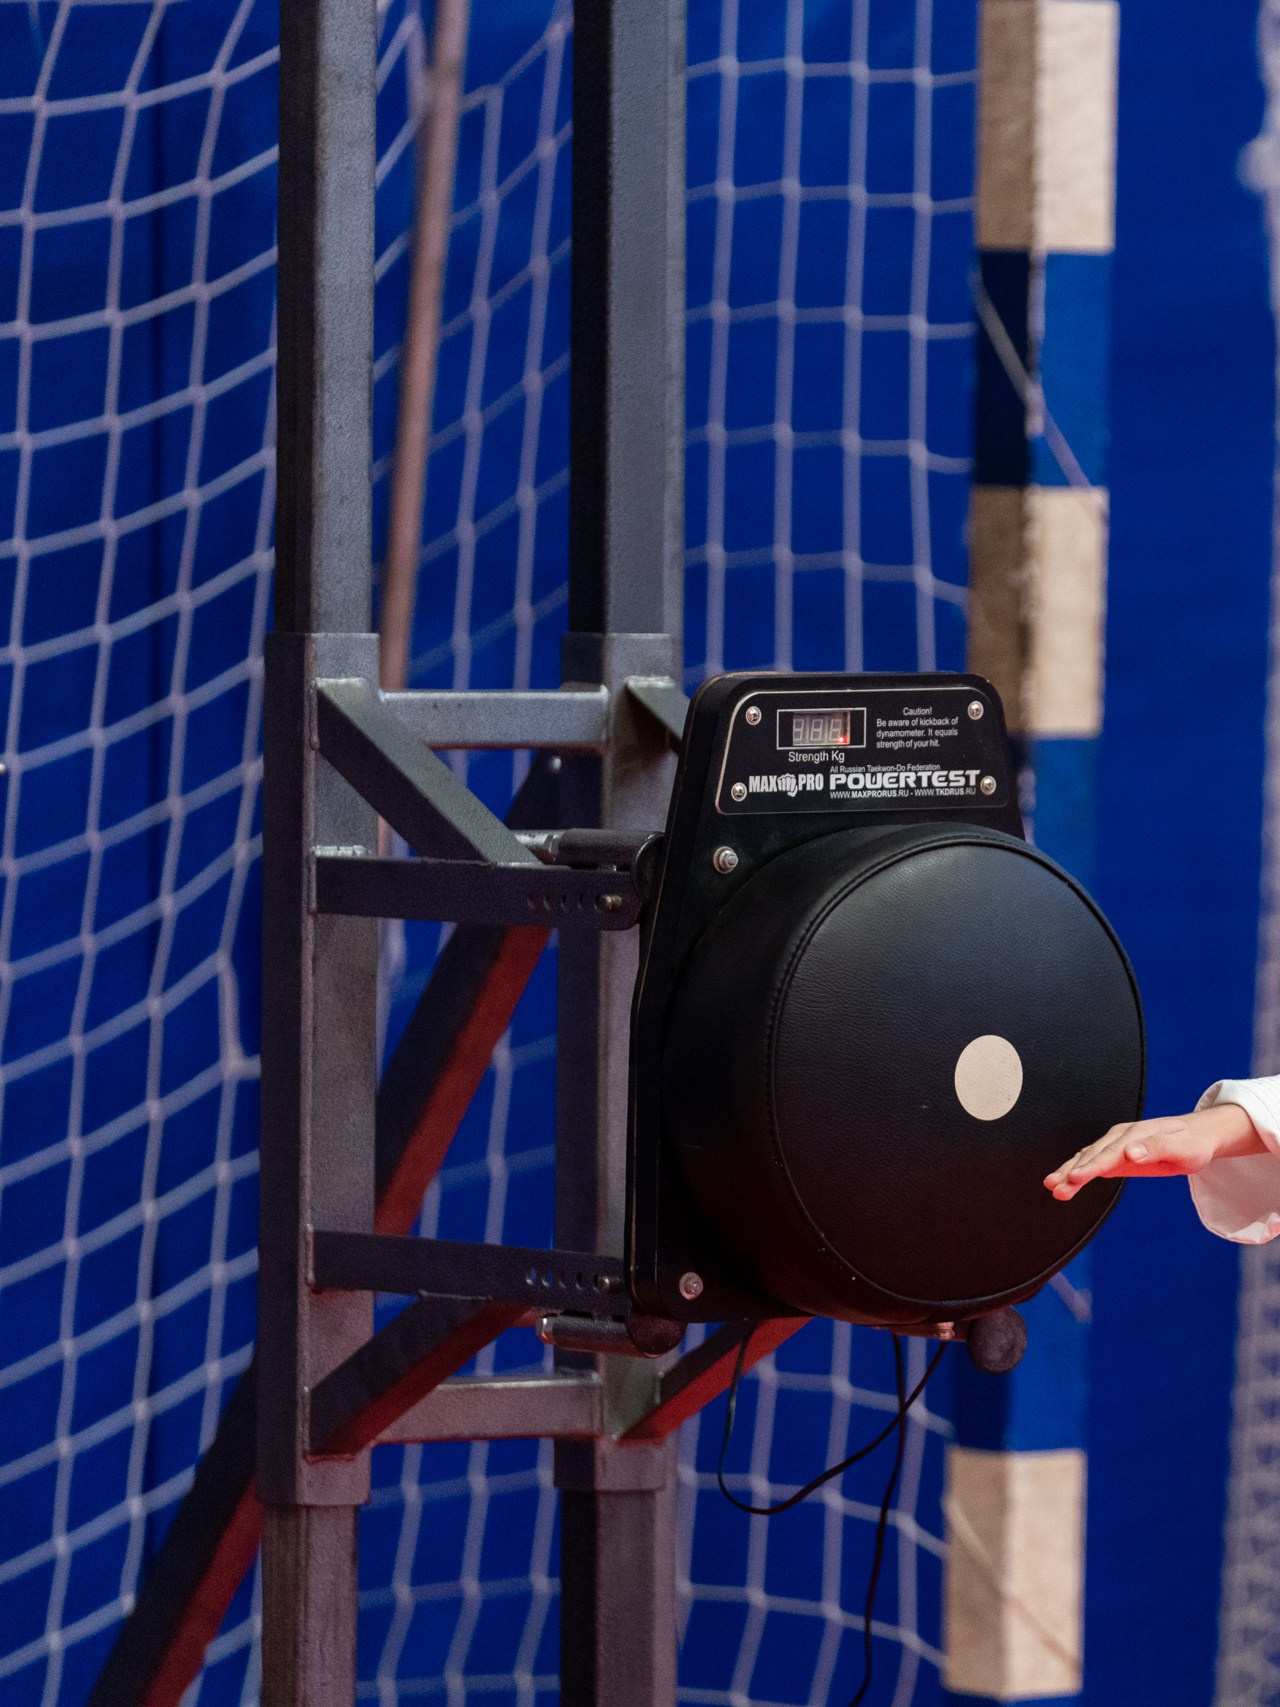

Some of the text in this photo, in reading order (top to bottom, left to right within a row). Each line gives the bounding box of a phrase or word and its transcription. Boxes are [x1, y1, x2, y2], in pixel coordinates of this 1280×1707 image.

[903, 706, 933, 716] Caution!
[876, 716, 959, 727] Be aware of kickback of
[876, 727, 959, 740] dynamometer. It equals
[876, 738, 940, 750] strength of your hit.
[788, 749, 845, 765] Strength Kg
[829, 762, 941, 774] All Russian Taekwon-Do Federation
[748, 773, 824, 793] MAX PRO
[829, 769, 981, 791] POWERTEST
[829, 788, 909, 799] WWW.MAXPRORUS.RU
[914, 787, 977, 797] WWW.TKDRUS.RU
